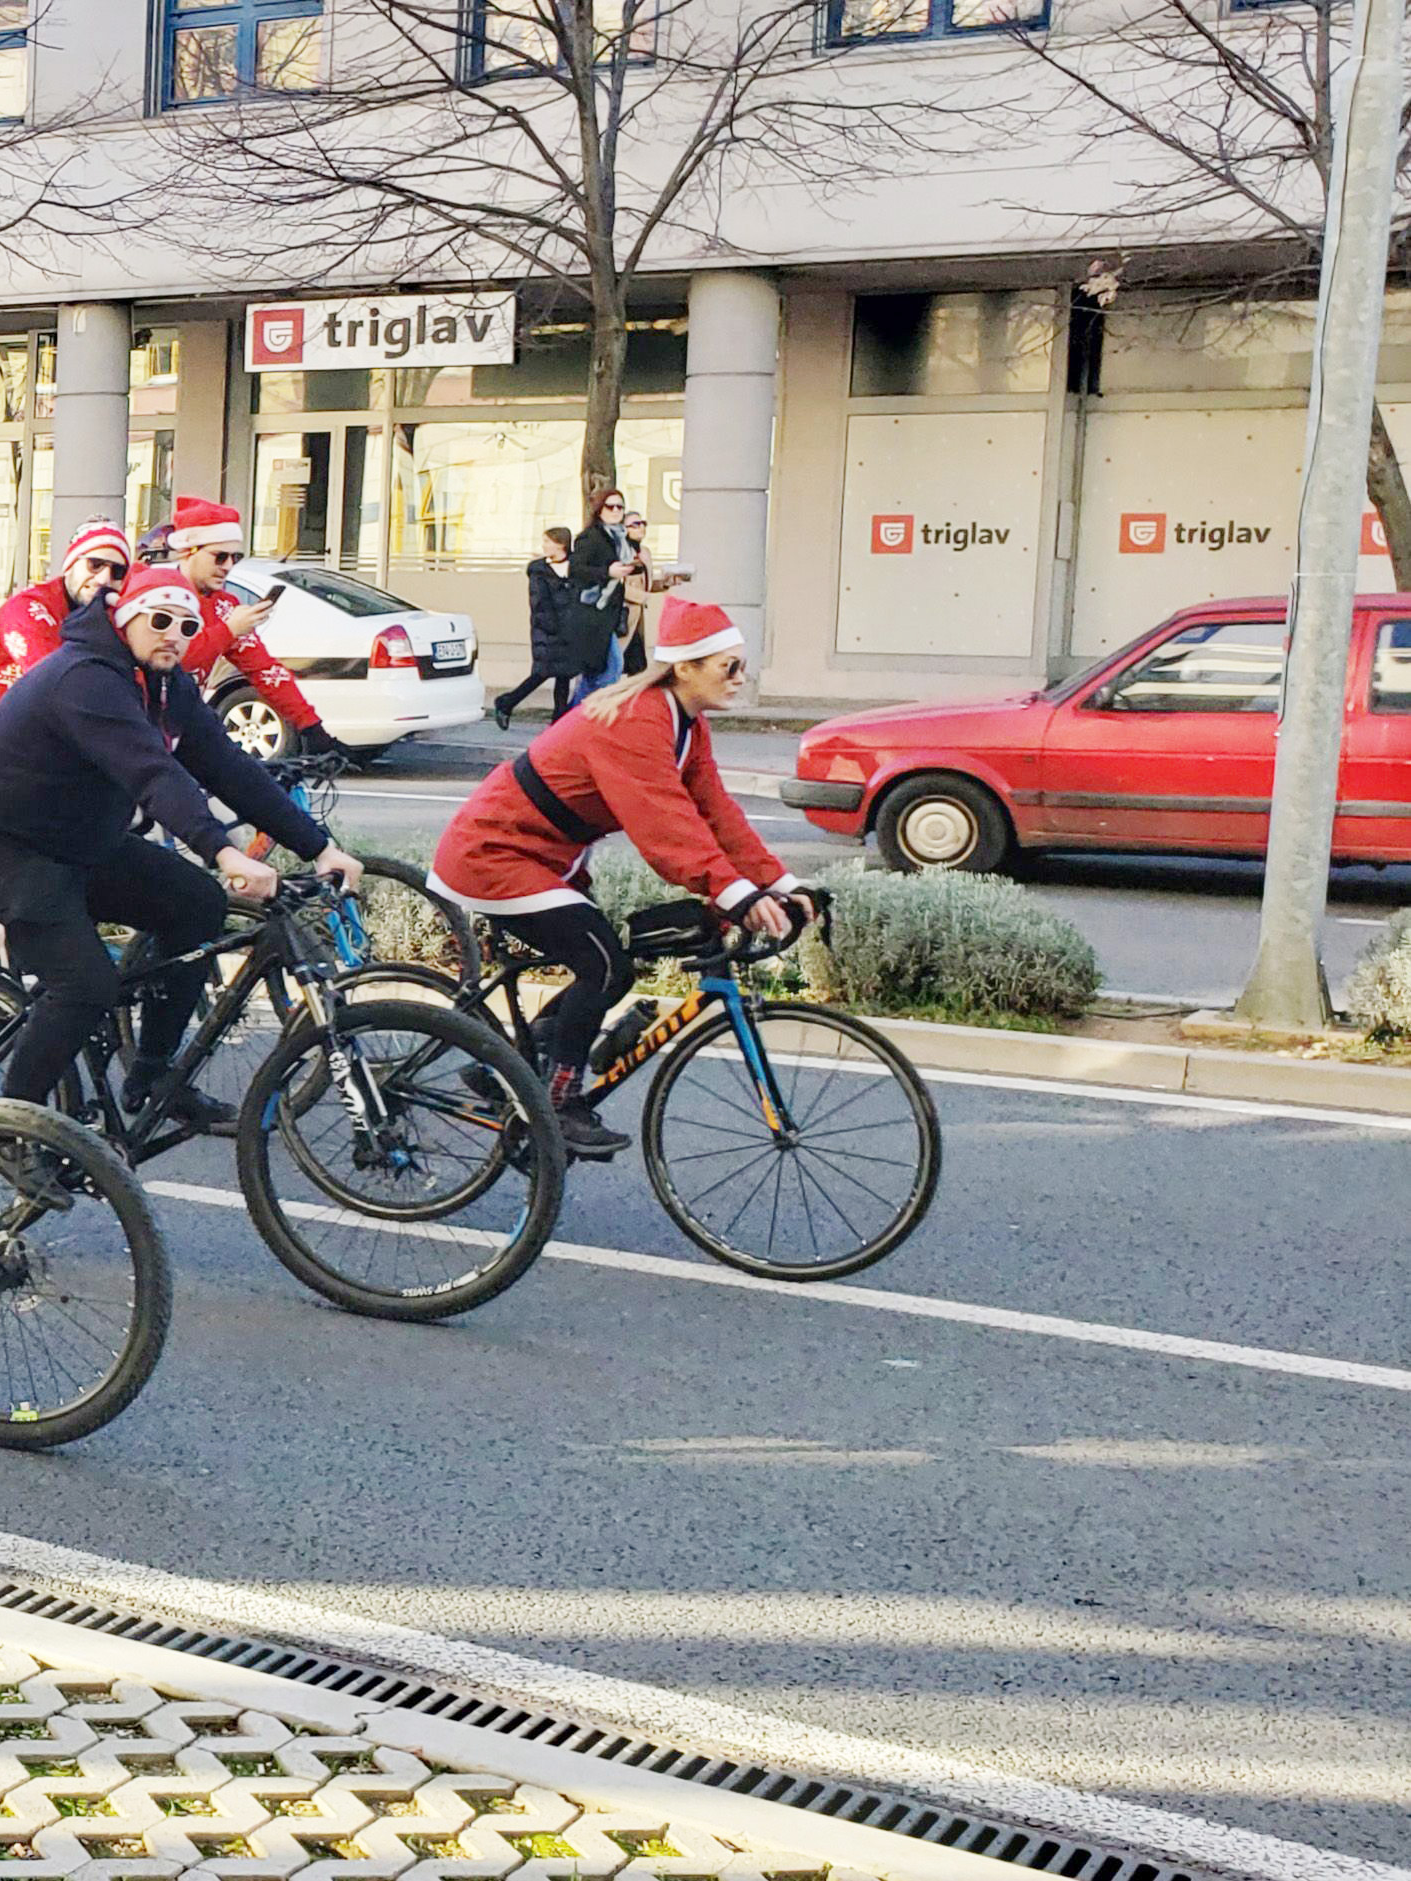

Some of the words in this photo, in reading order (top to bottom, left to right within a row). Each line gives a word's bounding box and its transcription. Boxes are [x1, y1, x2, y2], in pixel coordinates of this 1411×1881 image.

[323, 304, 493, 360] triglav
[920, 521, 1011, 552] triglav
[1173, 519, 1272, 552] triglav
